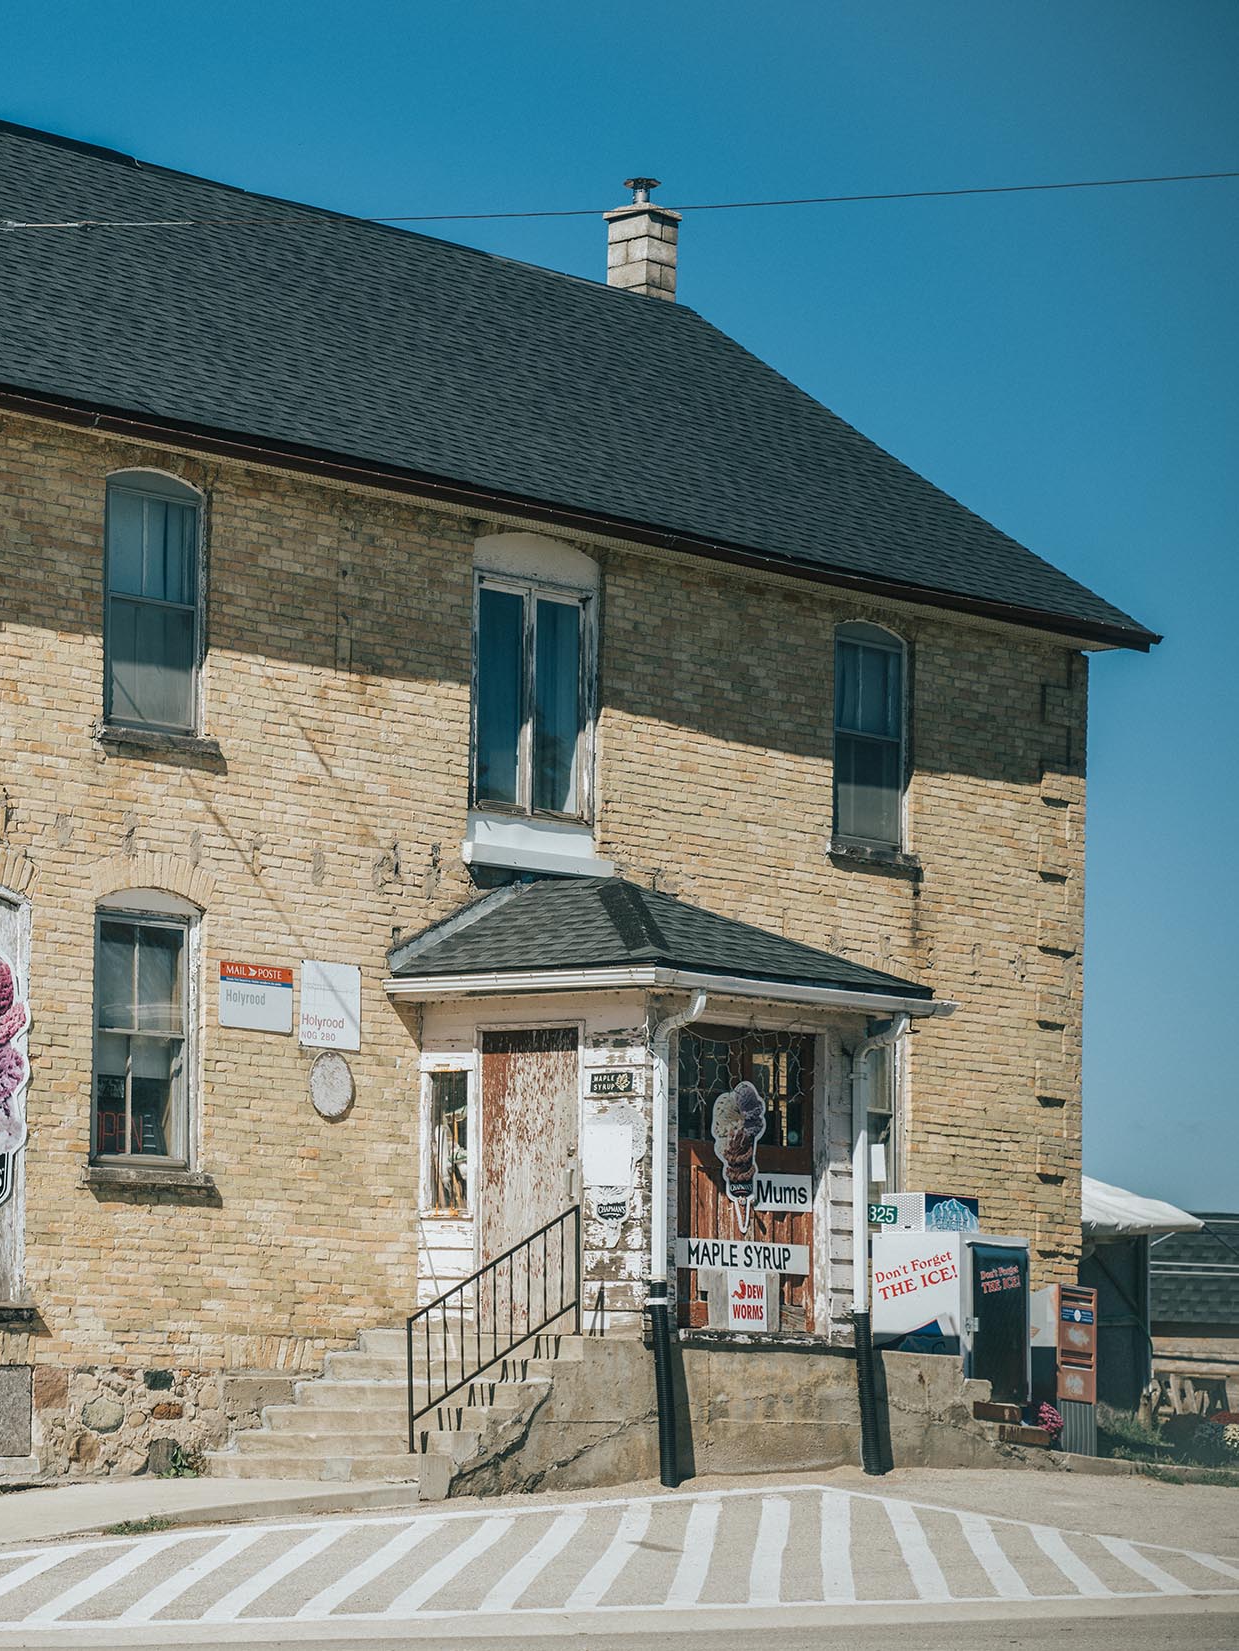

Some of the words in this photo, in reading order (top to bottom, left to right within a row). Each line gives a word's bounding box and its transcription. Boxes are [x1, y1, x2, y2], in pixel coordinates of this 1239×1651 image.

[226, 964, 247, 976] MAIL
[258, 968, 282, 980] POSTE
[226, 989, 266, 1006] Holyrood
[302, 1013, 344, 1031] Holyrood
[593, 1074, 616, 1082] MAPLE
[593, 1083, 616, 1091] SYRUP
[756, 1180, 808, 1205] Mums
[688, 1240, 739, 1267] MAPLE
[743, 1245, 792, 1271] SYRUP
[875, 1265, 909, 1283] Don't
[910, 1251, 953, 1272] Forget
[878, 1278, 918, 1301] THE
[920, 1264, 958, 1288] ICE!
[747, 1284, 764, 1299] DEW
[732, 1304, 764, 1321] WORMS
